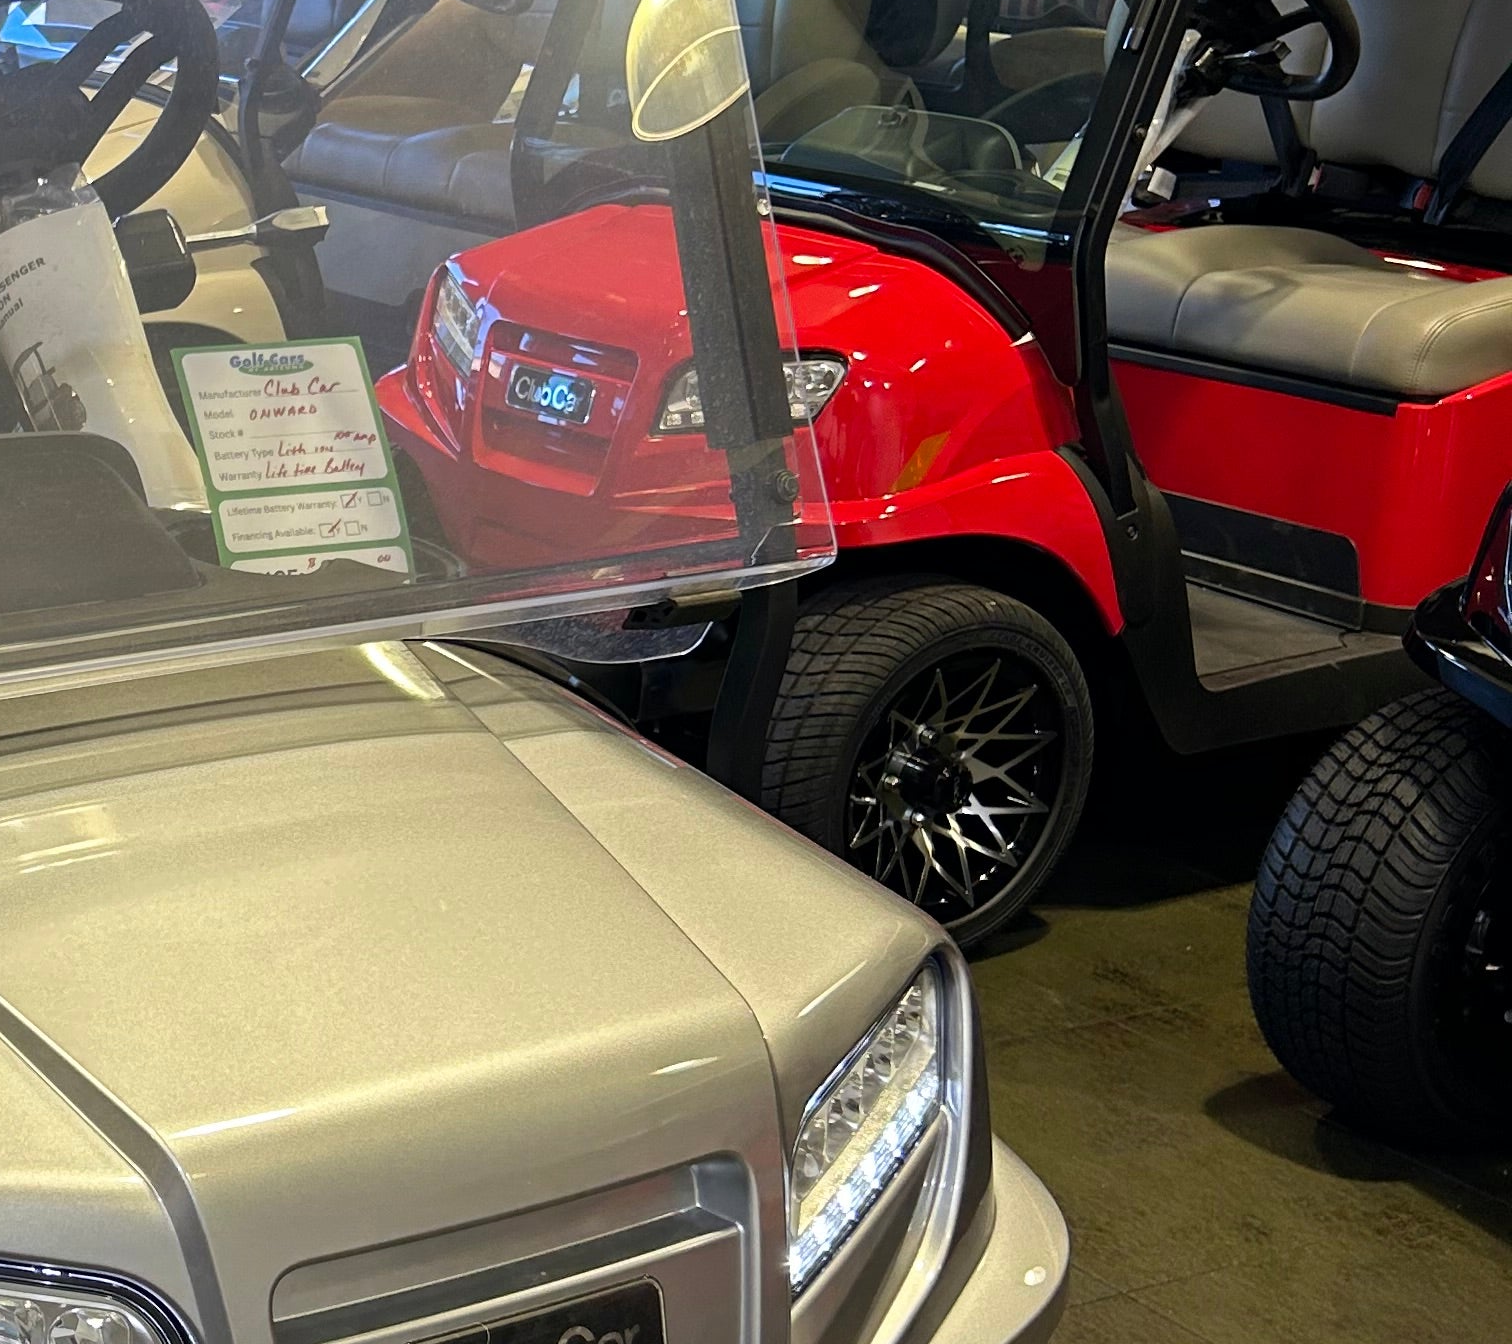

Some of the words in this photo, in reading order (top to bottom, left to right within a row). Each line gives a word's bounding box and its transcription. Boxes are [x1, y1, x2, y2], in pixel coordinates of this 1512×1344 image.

[229, 352, 264, 369] Golf
[269, 352, 305, 366] Cars
[198, 389, 262, 400] Manufacturer
[263, 378, 301, 397] Club
[307, 376, 341, 394] Car
[515, 376, 552, 407] Club
[249, 404, 318, 421] ONWARD
[208, 429, 235, 440] Stock
[214, 451, 249, 461] Battery
[251, 448, 274, 459] Type
[219, 471, 263, 481] Warranty
[227, 506, 262, 517] Lifetime
[264, 503, 295, 514] Battery
[232, 530, 274, 542] Financing
